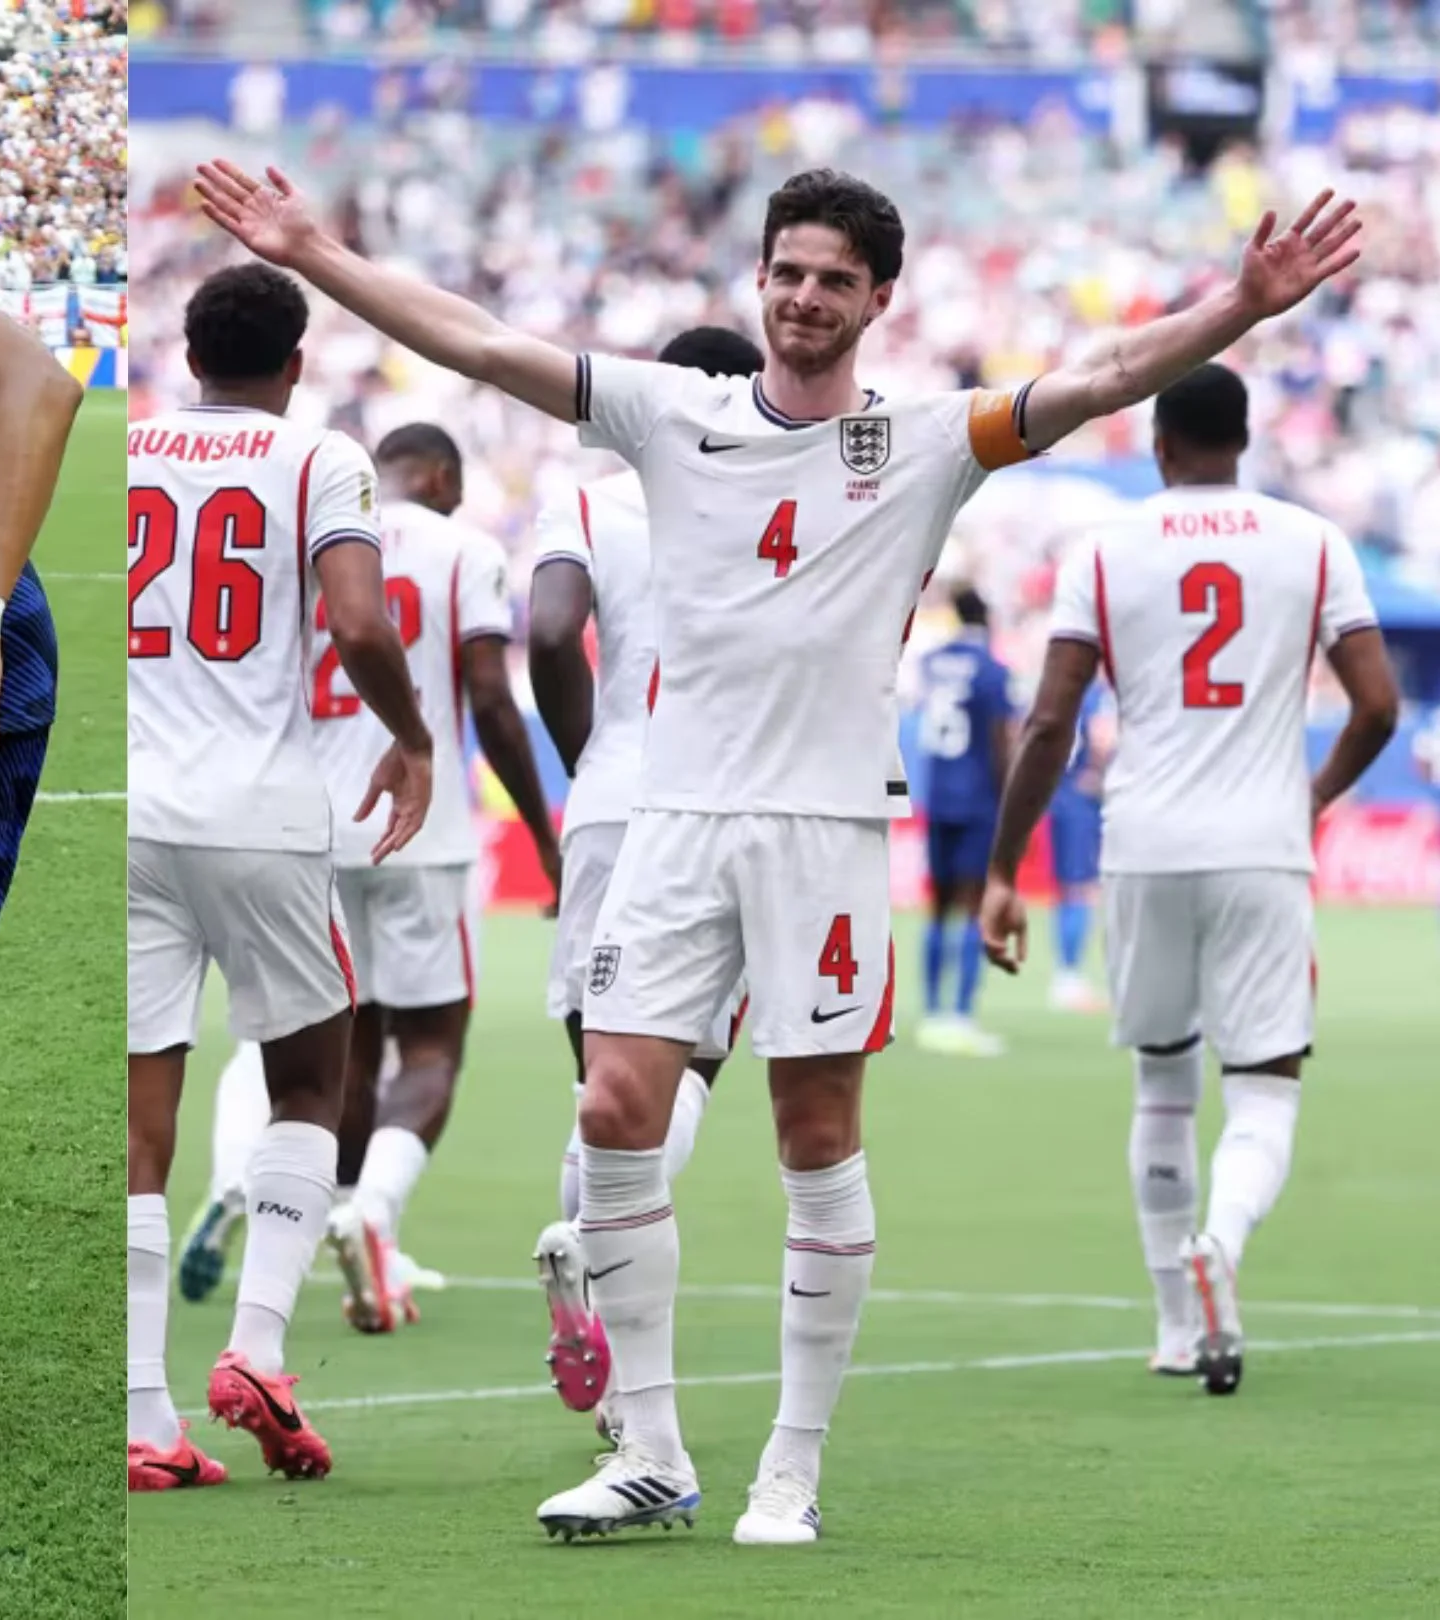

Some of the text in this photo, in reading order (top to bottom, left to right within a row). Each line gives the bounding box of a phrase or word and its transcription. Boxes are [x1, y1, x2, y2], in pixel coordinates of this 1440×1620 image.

[128, 428, 276, 463] QUANSAH
[757, 499, 799, 578] 4
[1162, 510, 1260, 539] KONSA
[128, 486, 266, 662] 26
[1179, 561, 1245, 709] 2
[818, 913, 859, 995] 4
[257, 1200, 303, 1222] ENG
